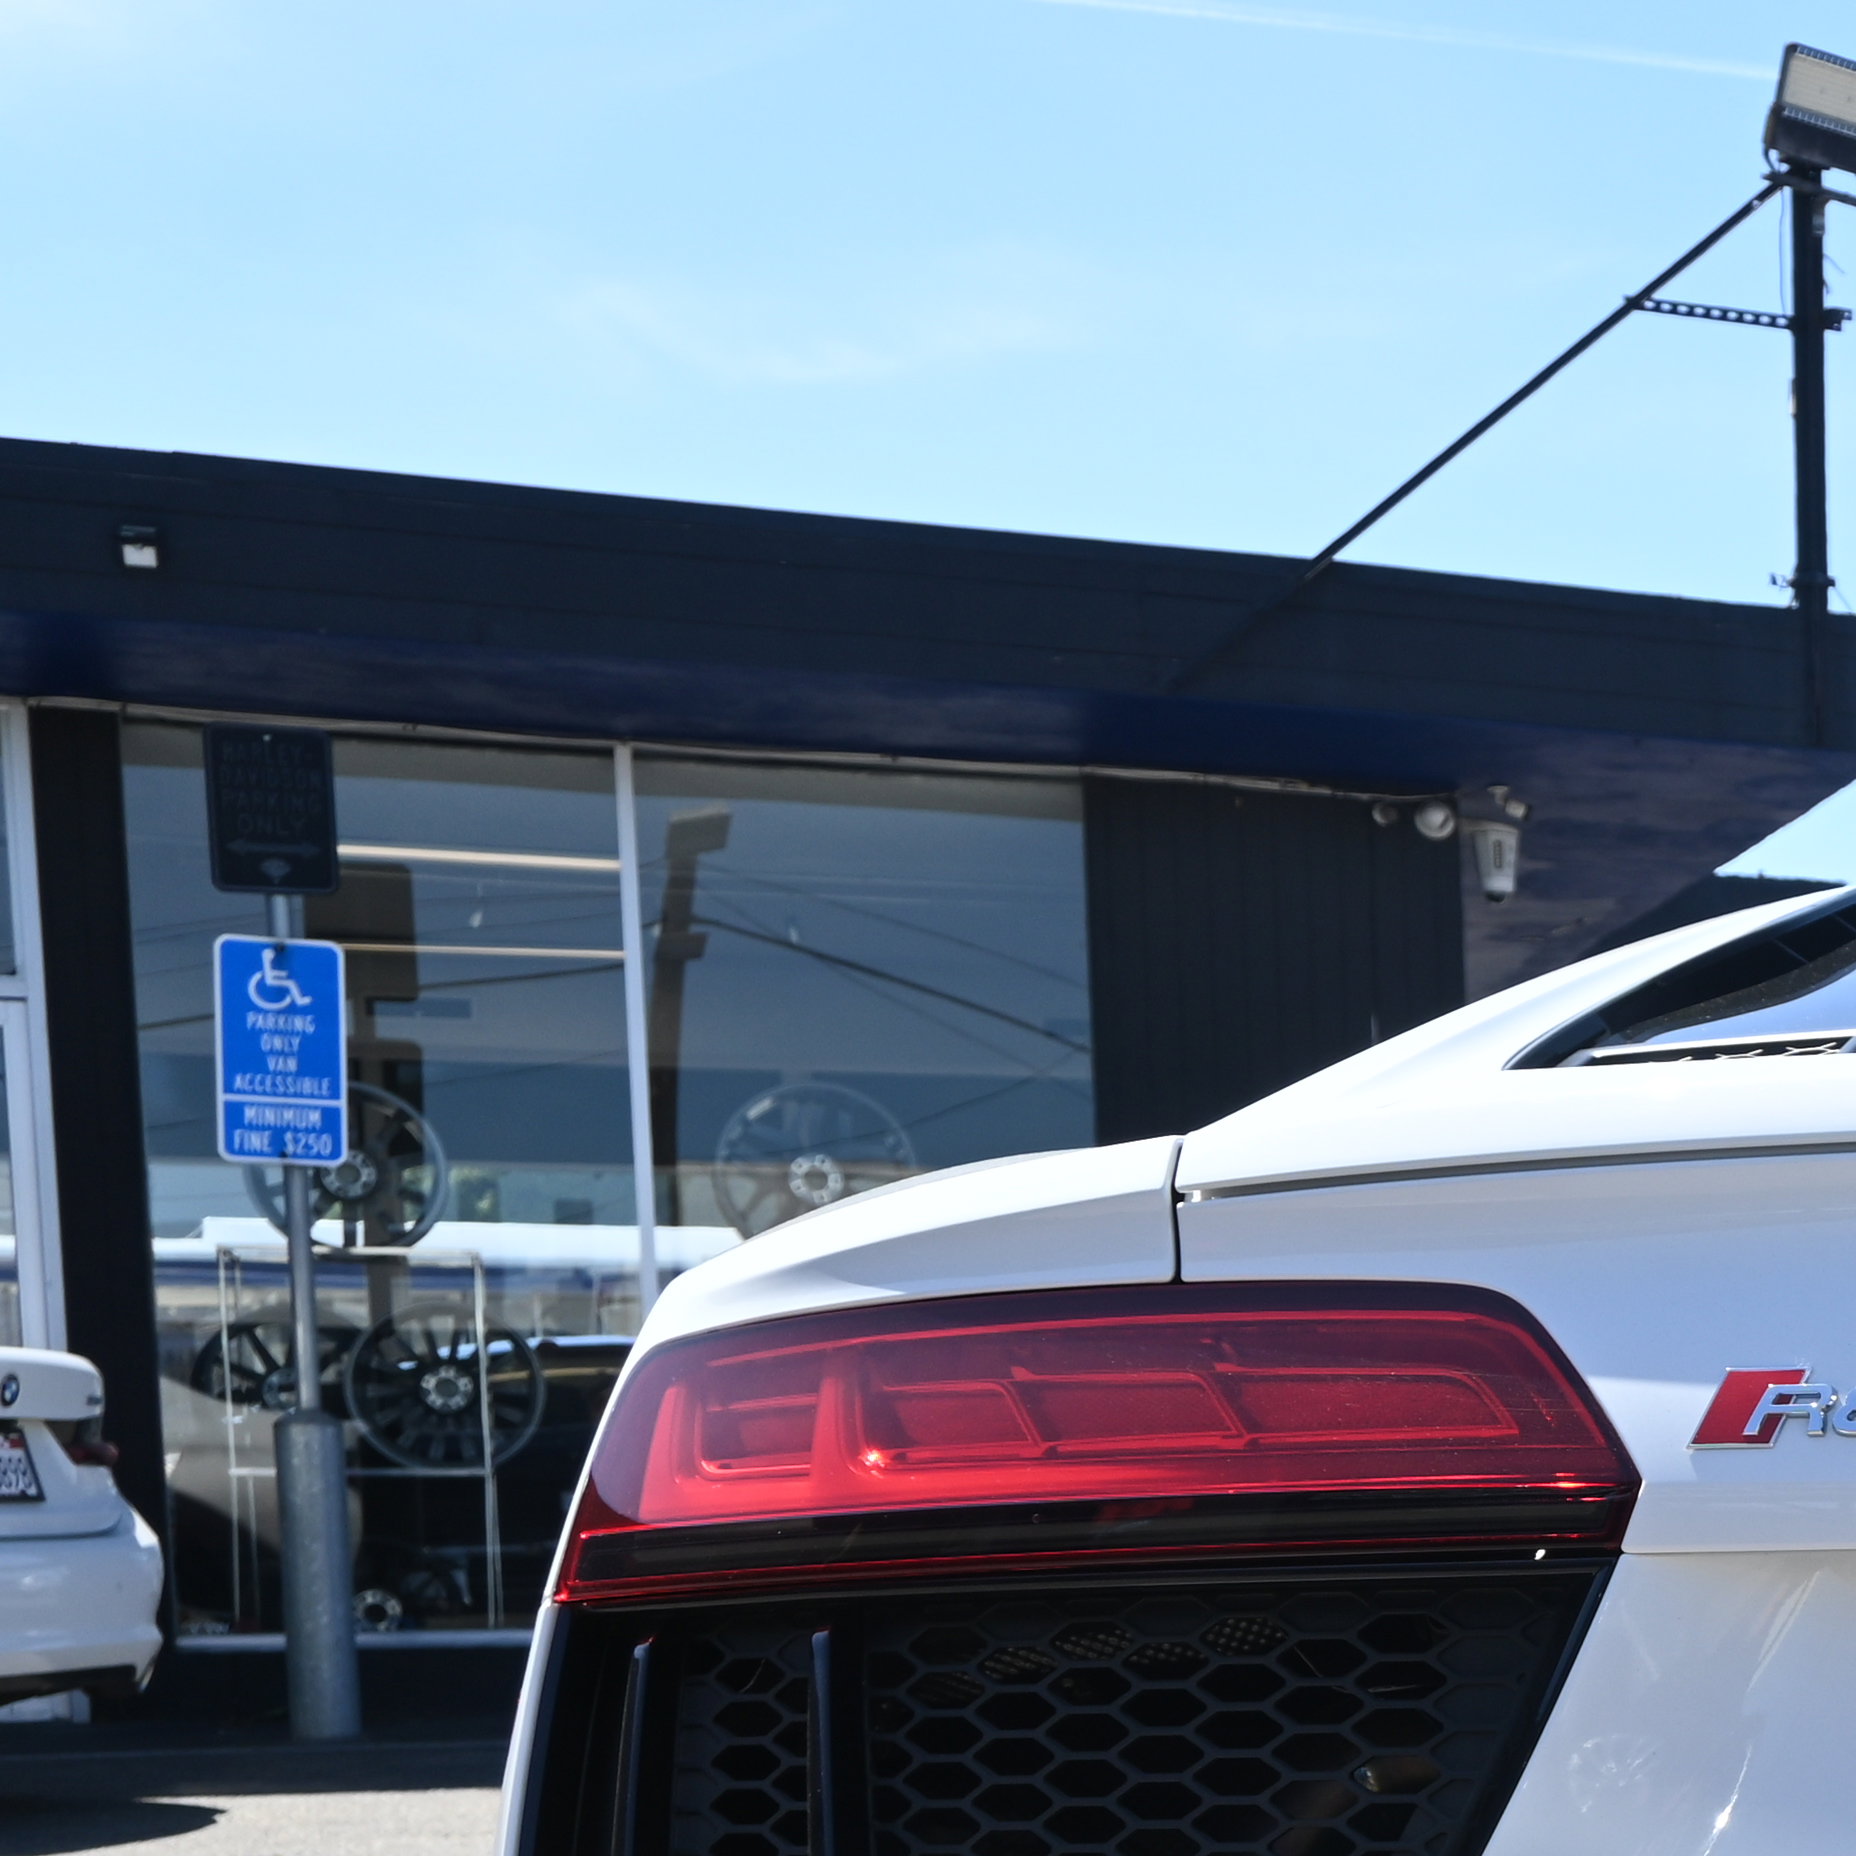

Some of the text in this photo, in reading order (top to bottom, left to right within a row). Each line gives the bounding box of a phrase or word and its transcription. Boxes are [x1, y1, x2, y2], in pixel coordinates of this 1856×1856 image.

[246, 1011, 315, 1034] PARKING
[260, 1032, 301, 1052] ONLY
[266, 1052, 298, 1072] VAN
[234, 1073, 331, 1096] ACCESSIBLE
[243, 1104, 321, 1130] MINIMUM
[233, 1129, 332, 1157] FINE $250
